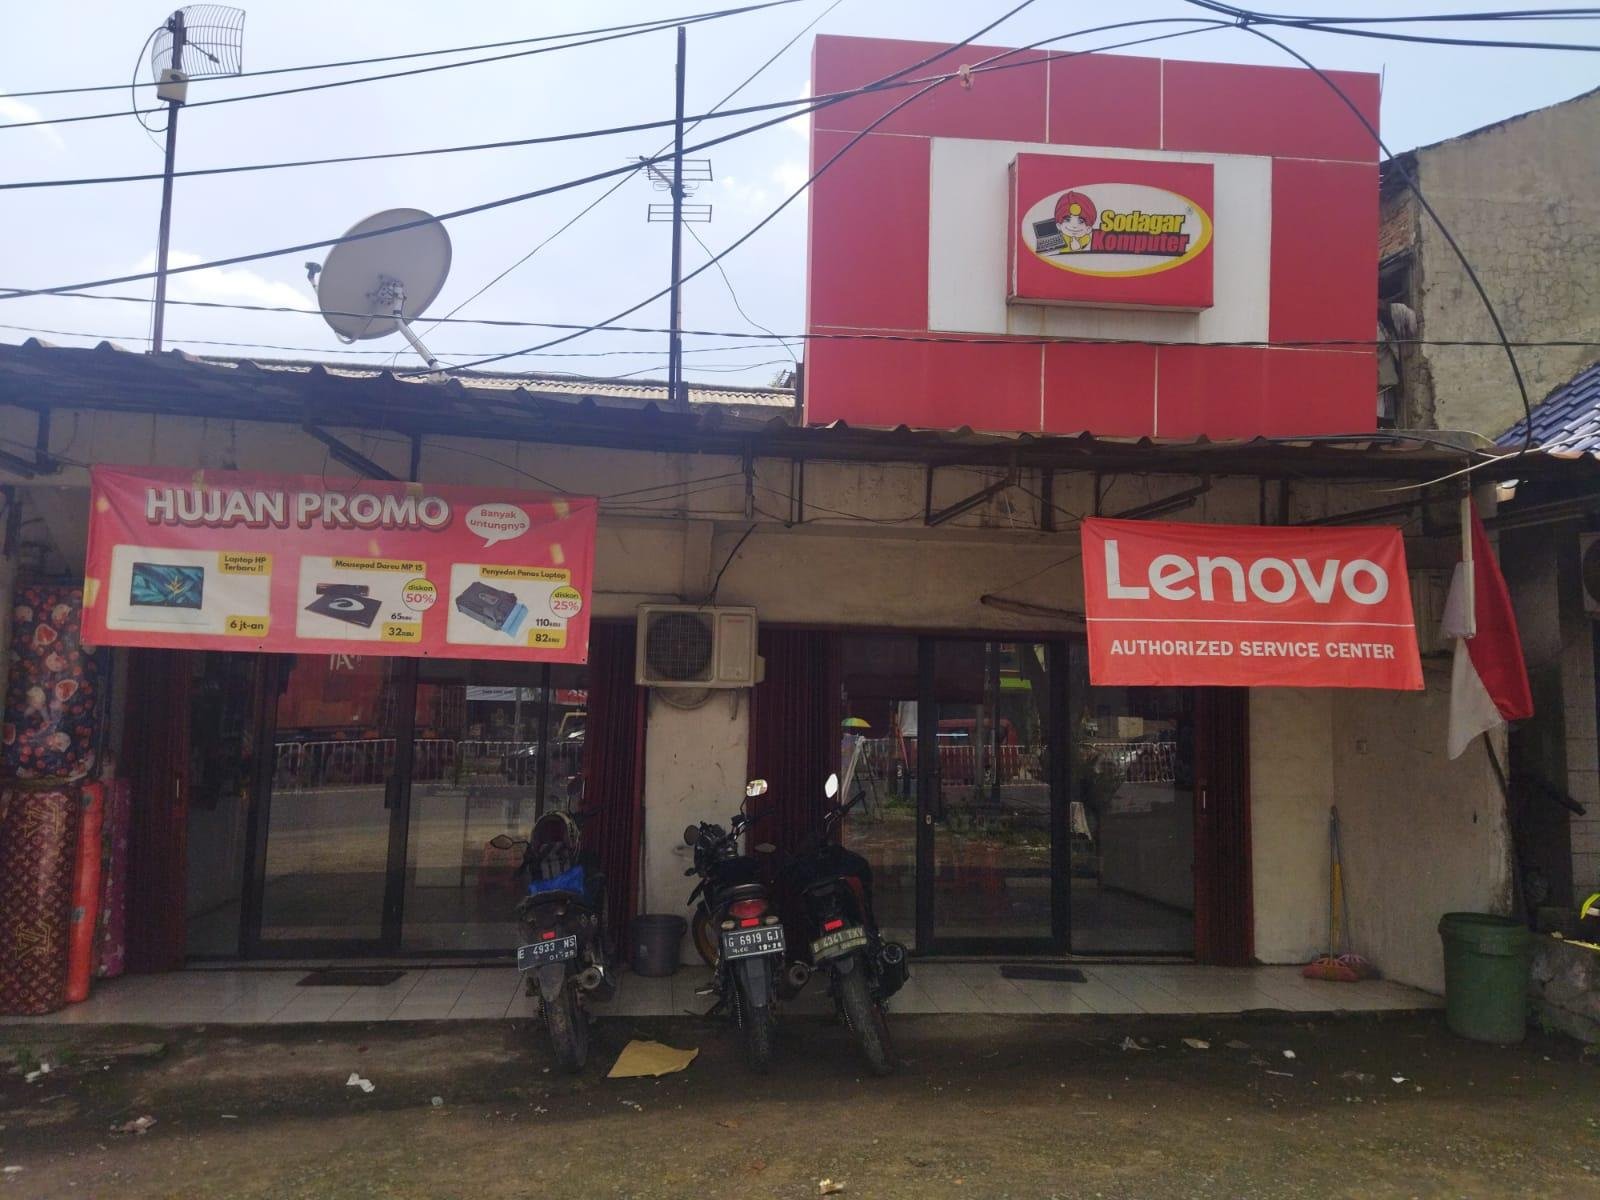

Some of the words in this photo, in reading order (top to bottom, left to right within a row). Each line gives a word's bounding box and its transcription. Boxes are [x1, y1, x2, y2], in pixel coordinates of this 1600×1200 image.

[1100, 209, 1186, 235] Sodagar
[1091, 229, 1191, 254] Komputer
[146, 487, 288, 528] HUJAN
[296, 491, 451, 530] PROMO
[480, 508, 516, 519] Banyak
[470, 519, 526, 531] untungnya
[224, 555, 253, 565] Laptop
[335, 559, 375, 570] Mousepad
[401, 563, 413, 571] MP
[224, 563, 256, 572] Terbaru
[1104, 539, 1389, 605] Lenovo
[517, 569, 540, 577] Panas
[540, 570, 567, 580] Laptop
[408, 584, 433, 592] diskon
[406, 593, 434, 604] 50%
[554, 591, 579, 599] diskon
[554, 600, 579, 611] 25%
[230, 619, 238, 629] 6
[238, 619, 264, 631] jt-an
[1110, 639, 1234, 657] AUTHORIZED
[1239, 641, 1320, 659] SERVICE
[1326, 643, 1395, 660] CENTER
[739, 932, 762, 946] 6919
[518, 949, 525, 960] E
[532, 942, 555, 956] 4933
[563, 937, 575, 949] NS
